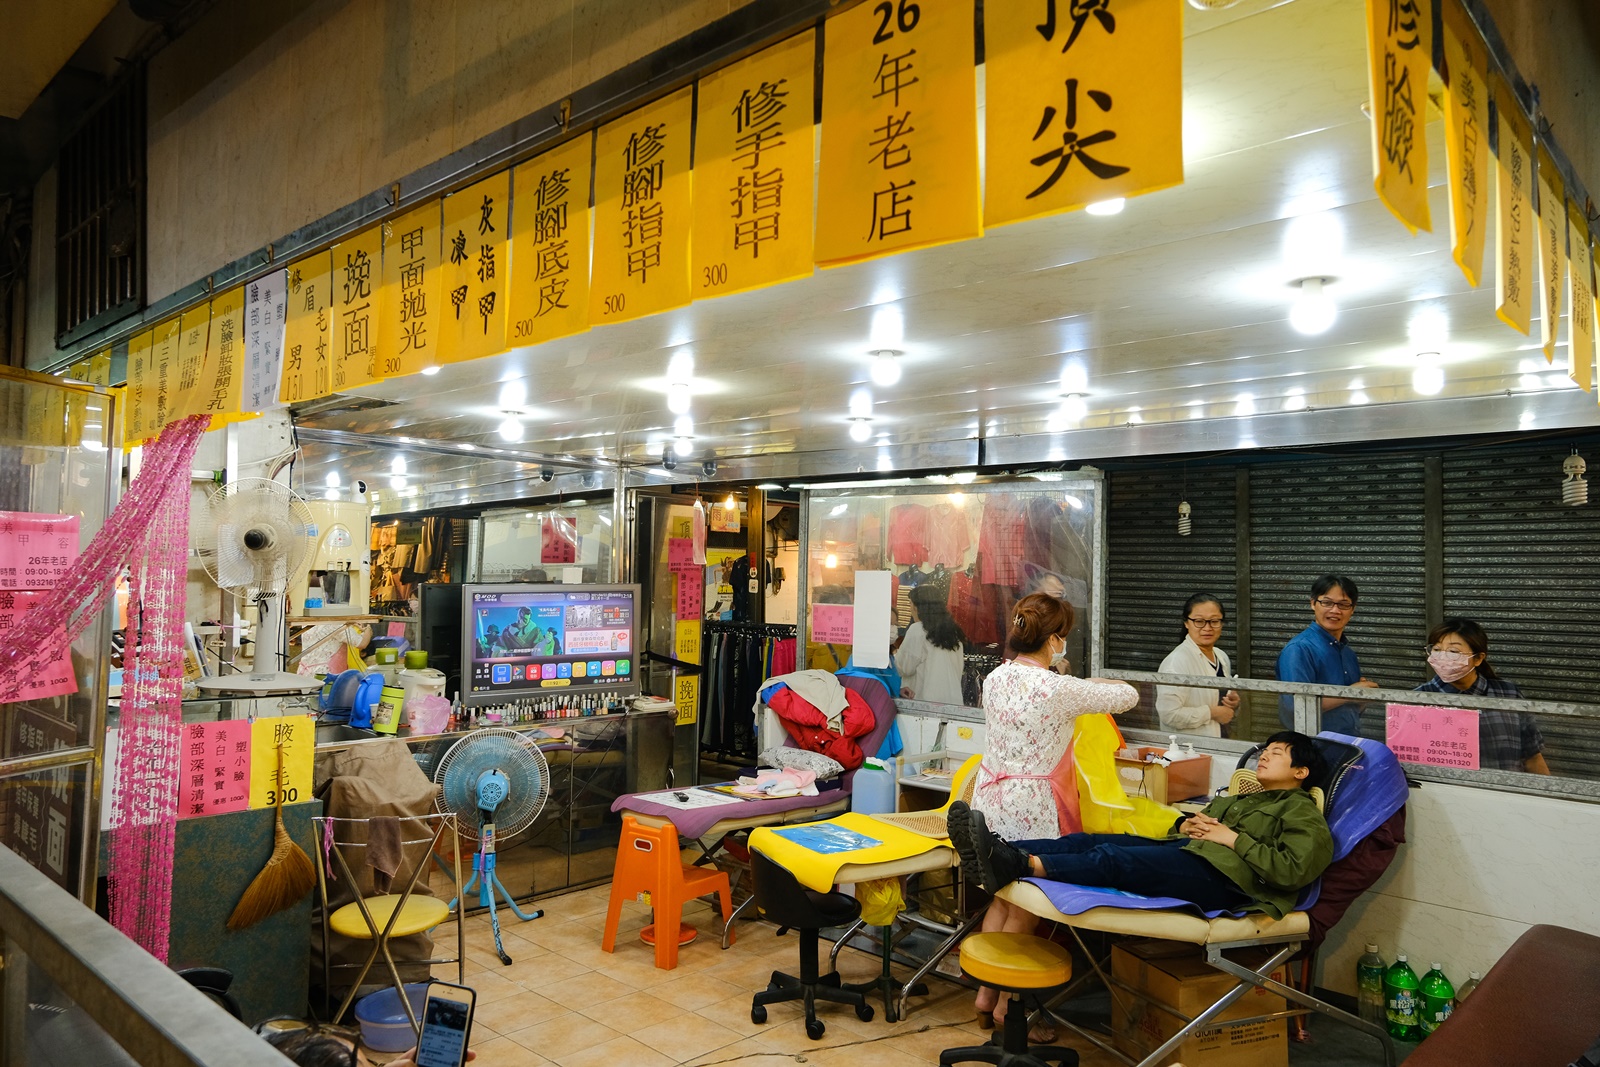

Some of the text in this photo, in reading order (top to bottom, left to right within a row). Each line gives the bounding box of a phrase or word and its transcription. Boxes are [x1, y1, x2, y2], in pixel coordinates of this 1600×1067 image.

[865, 0, 921, 243] 26年老店
[703, 78, 790, 288] 修手指甲 300
[603, 122, 667, 316] 修腳指甲 500
[477, 194, 498, 335] 灰指甲
[514, 168, 571, 338] 修腳底皮 500
[343, 250, 371, 361] 挽面
[286, 268, 327, 401] 修眉毛 男 150 女 120
[335, 371, 345, 387] 300
[384, 357, 401, 374] 300
[28, 556, 68, 566] 26年老店
[50, 677, 68, 685] 1000
[680, 681, 694, 721] 挽面
[19, 720, 44, 751] 修指甲
[1430, 740, 1468, 751] 26年老店
[190, 724, 205, 815] 臉部深層清潔
[233, 741, 247, 782] 塑小臉
[1426, 756, 1471, 767] 0932161320
[46, 737, 70, 876] 挽面
[266, 787, 298, 806] 300
